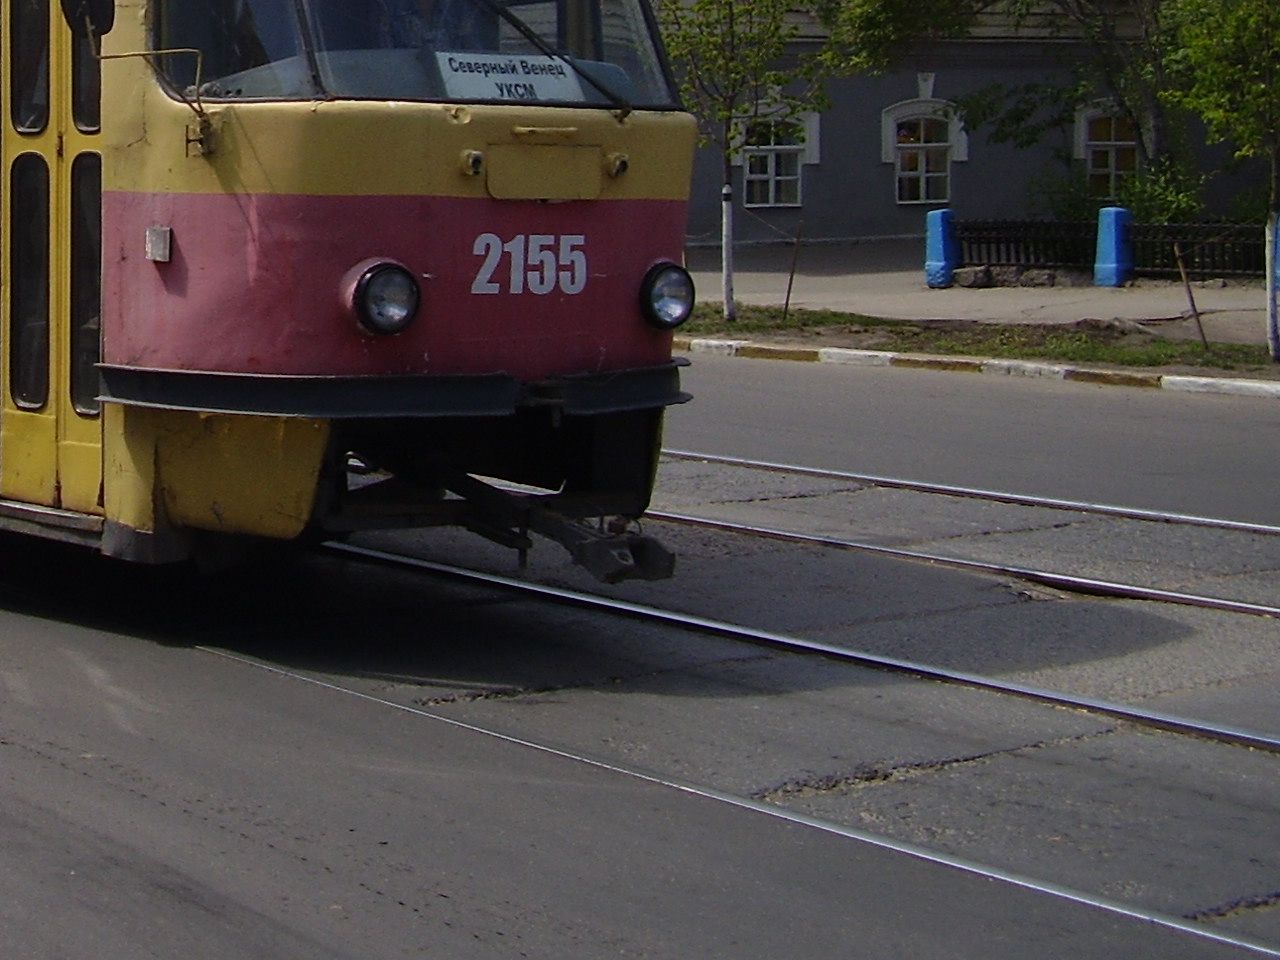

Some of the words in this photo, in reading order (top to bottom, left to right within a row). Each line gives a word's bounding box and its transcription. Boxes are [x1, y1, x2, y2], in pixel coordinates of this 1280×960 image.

[448, 57, 518, 78] Северный
[520, 60, 567, 78] Венец
[495, 82, 537, 98] УКСМ
[471, 233, 587, 294] 2155
